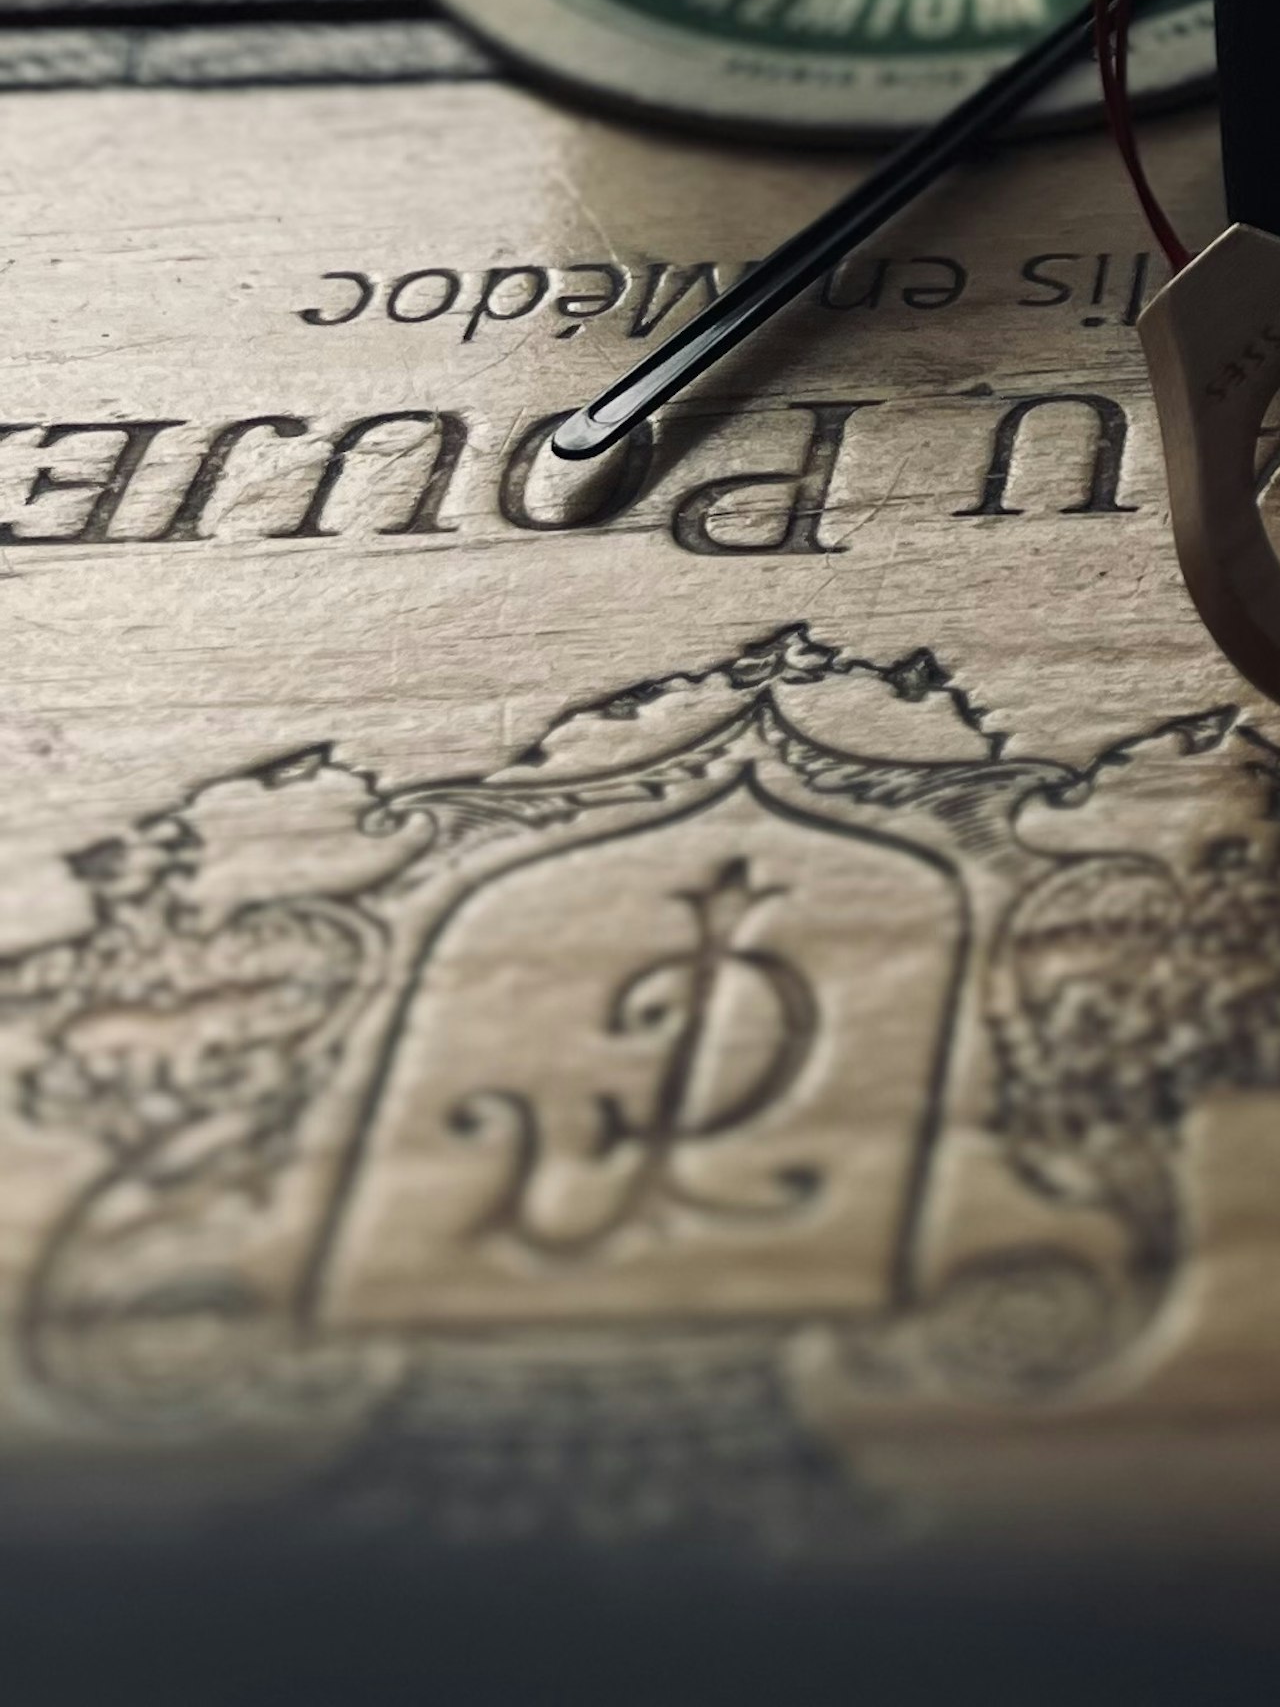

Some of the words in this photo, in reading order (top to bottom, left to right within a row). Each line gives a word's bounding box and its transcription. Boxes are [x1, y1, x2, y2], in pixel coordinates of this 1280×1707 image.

[298, 254, 727, 346] Médoc
[816, 249, 968, 313] en
[0, 397, 884, 557] POUJE
